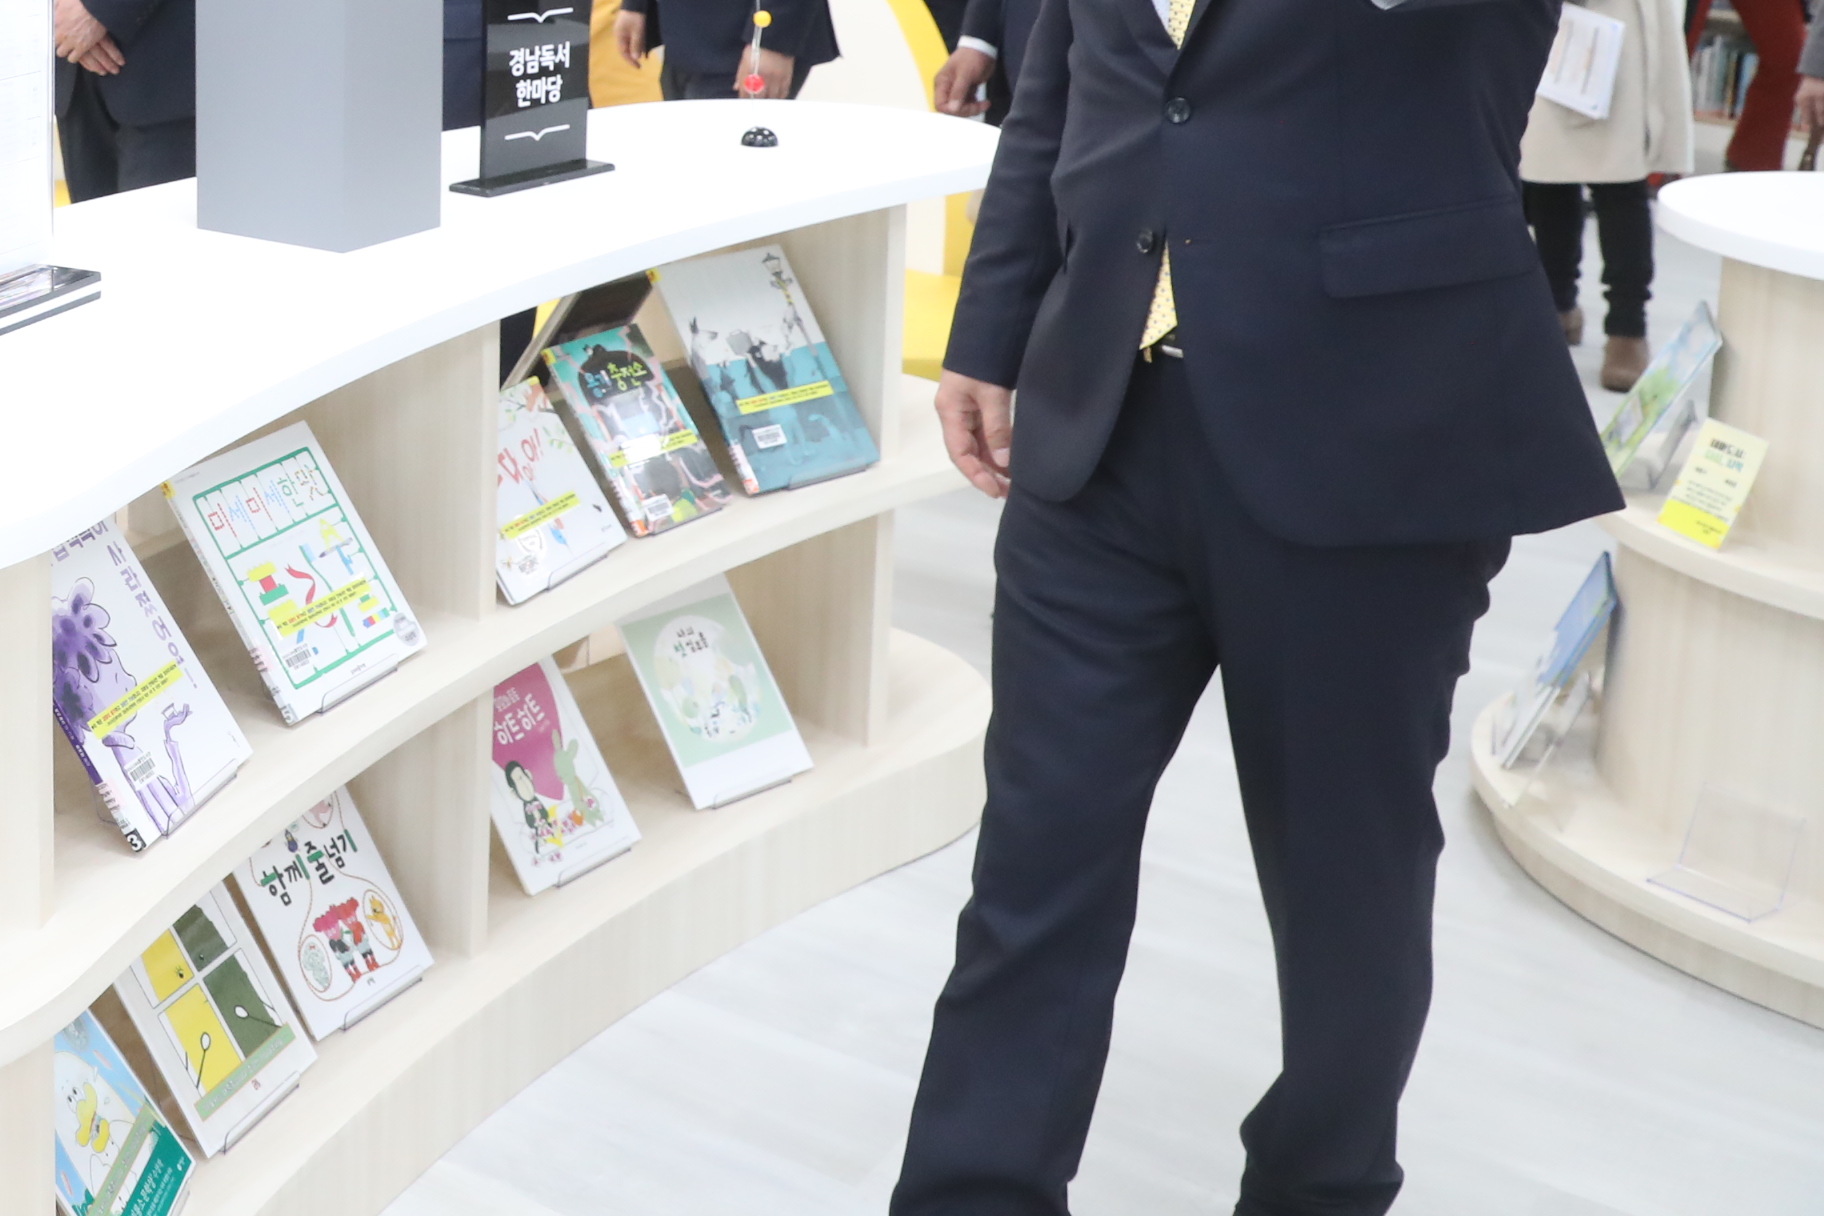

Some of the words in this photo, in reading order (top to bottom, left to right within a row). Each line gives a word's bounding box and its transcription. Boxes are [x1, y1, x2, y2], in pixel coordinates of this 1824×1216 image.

[509, 41, 570, 77] 경남독서
[515, 74, 563, 108] 한마당
[127, 834, 143, 853] 3
[260, 854, 311, 906] 함께
[304, 829, 358, 885] 줄넘기
